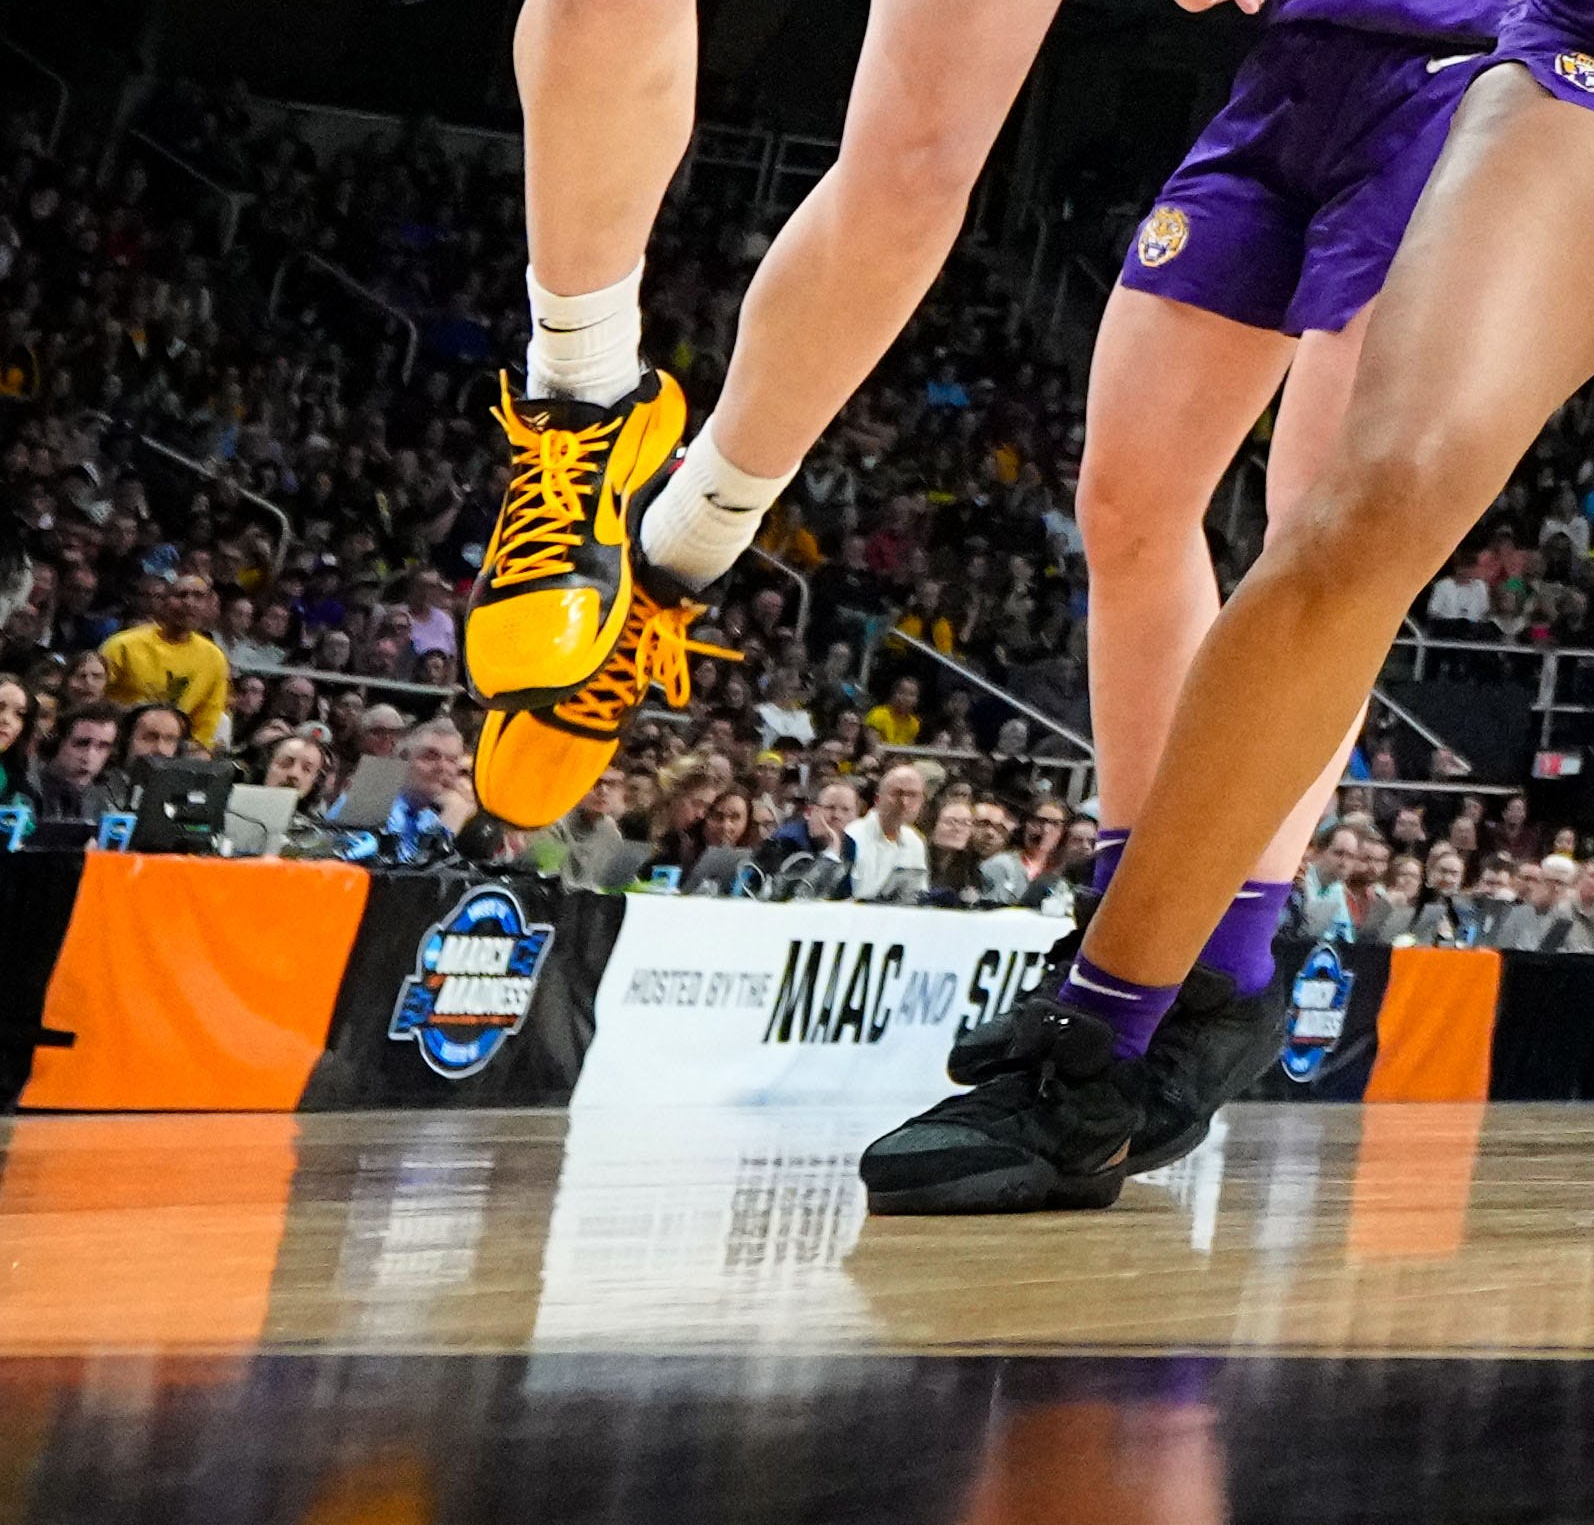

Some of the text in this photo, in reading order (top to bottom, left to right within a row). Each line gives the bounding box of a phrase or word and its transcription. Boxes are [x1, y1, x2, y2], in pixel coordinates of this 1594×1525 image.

[622, 968, 774, 1008] HOSTED BY THE
[760, 939, 905, 1045] MAAC
[897, 969, 958, 1025] AND
